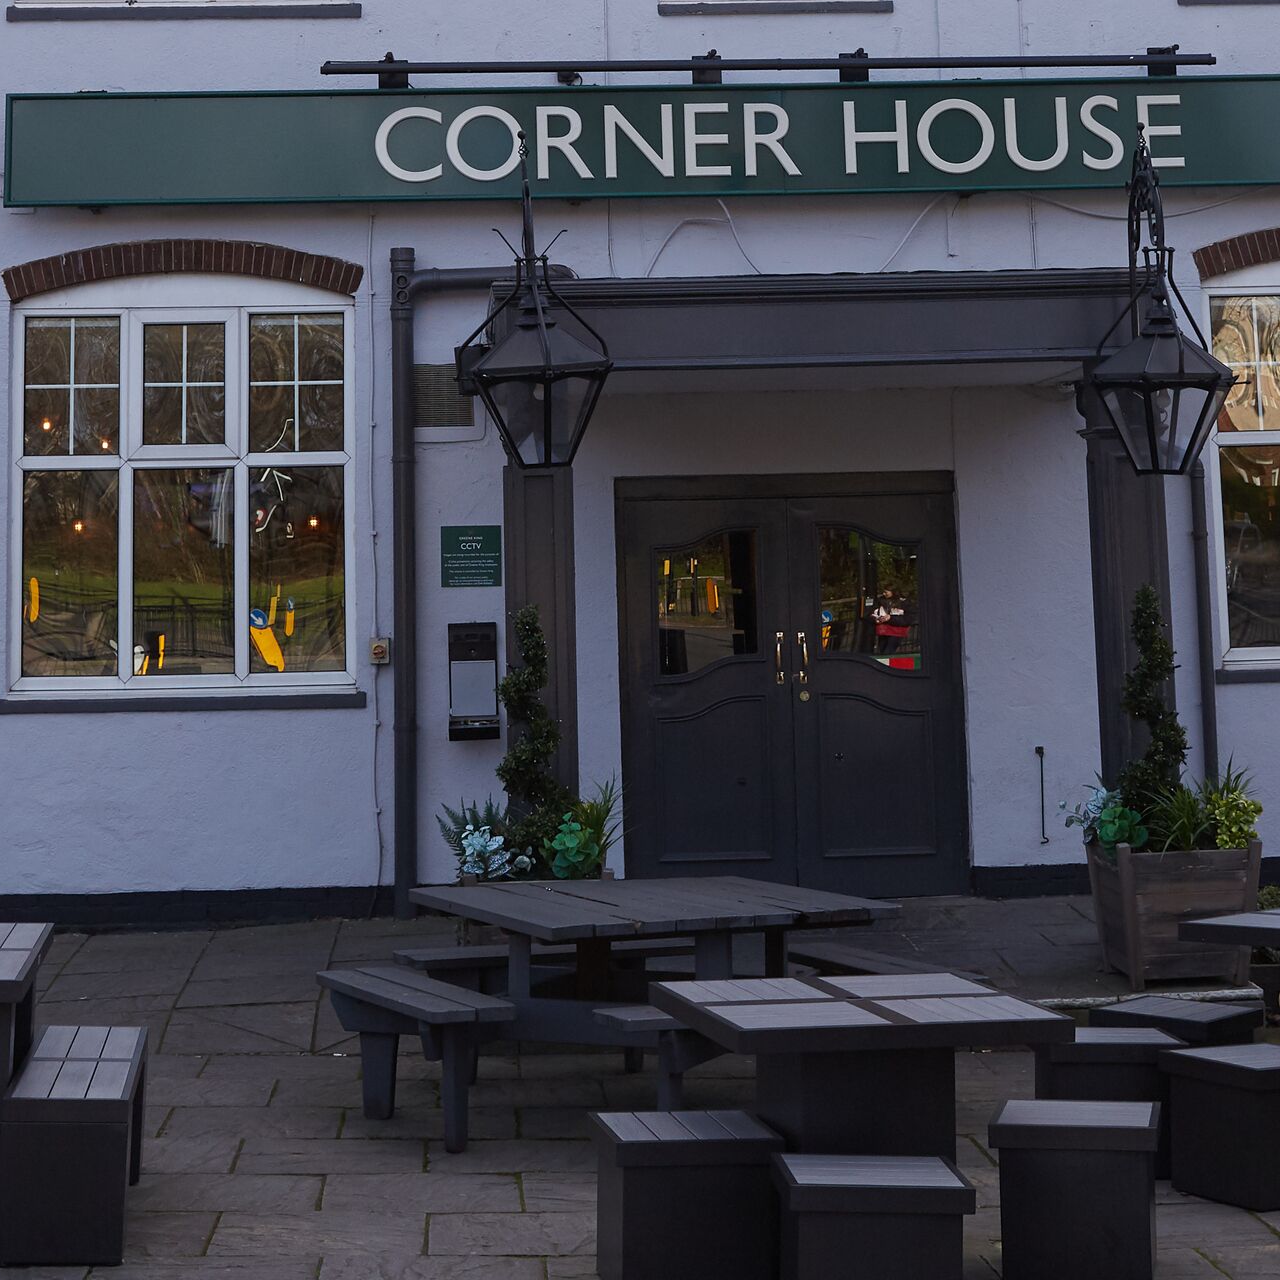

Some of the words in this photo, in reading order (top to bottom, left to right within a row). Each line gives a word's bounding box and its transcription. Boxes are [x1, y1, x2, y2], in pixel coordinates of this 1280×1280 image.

[375, 102, 802, 183] CORNER
[842, 93, 1186, 175] HOUSE
[460, 542, 482, 550] CCTV
